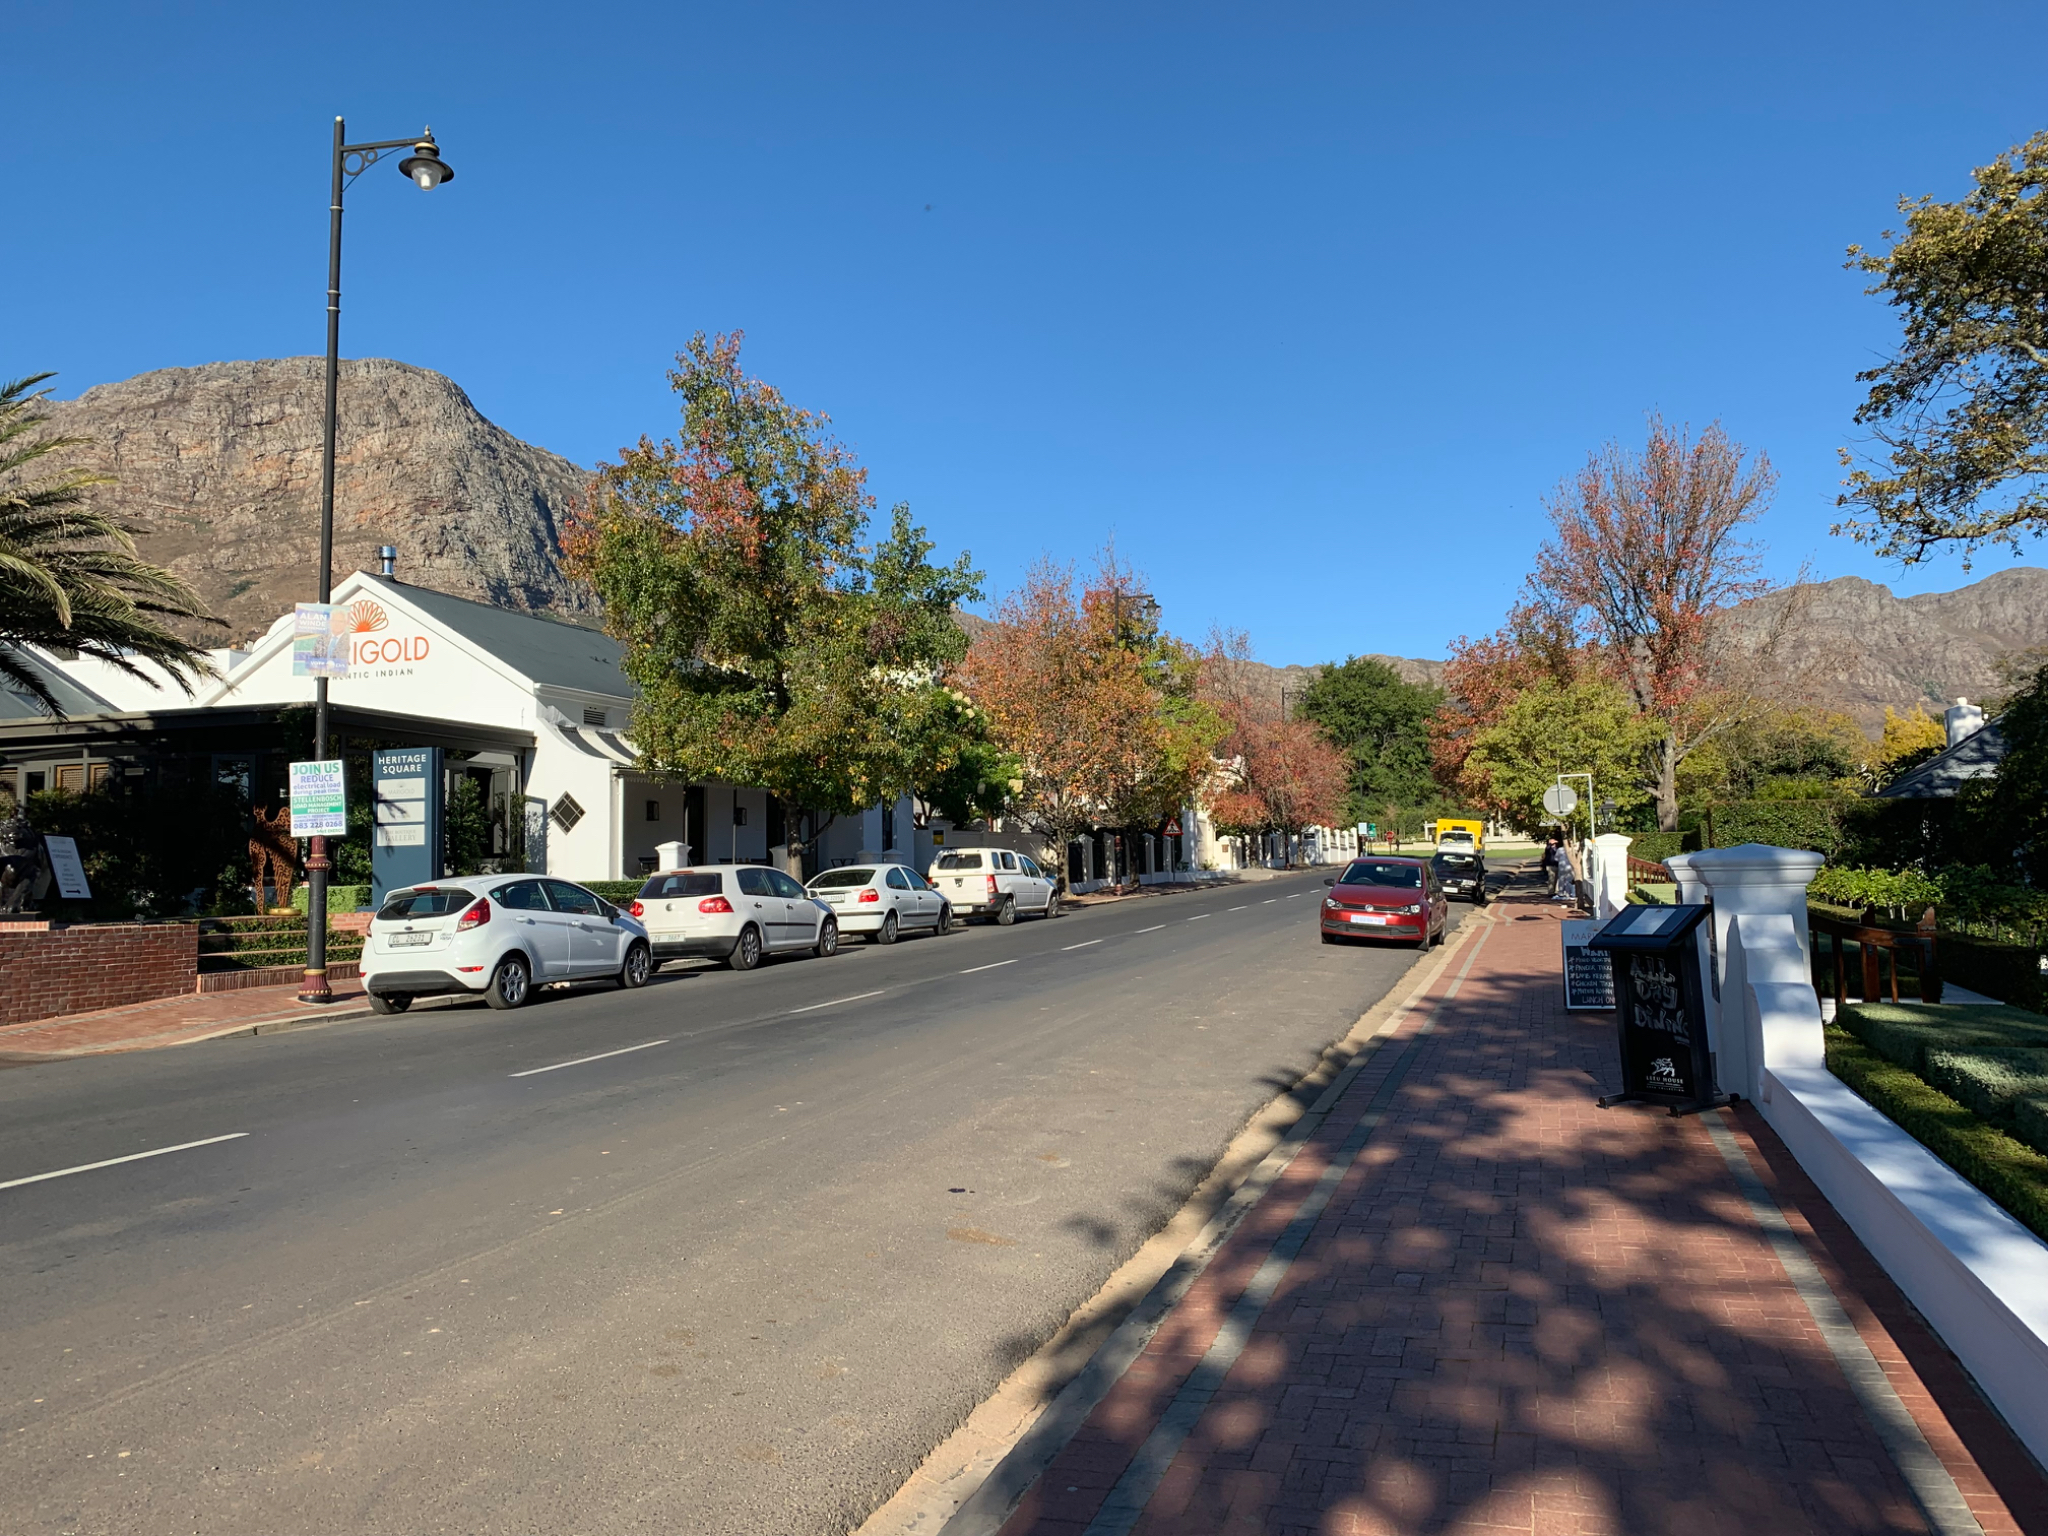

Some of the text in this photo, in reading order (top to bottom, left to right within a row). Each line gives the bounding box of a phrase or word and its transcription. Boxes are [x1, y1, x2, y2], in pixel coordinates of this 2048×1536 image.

[300, 612, 327, 621] ALAN
[348, 636, 430, 665] IGOLD
[375, 668, 413, 677] INDIAN
[378, 754, 427, 765] HERITAGE
[292, 762, 340, 775] JOIN US
[382, 764, 422, 774] SQUARE
[300, 774, 334, 783] REDUCE
[293, 795, 342, 803] STELLENBOSCH
[325, 820, 343, 828] 0268
[385, 834, 416, 842] GALLERY
[1571, 933, 1594, 941] MARI
